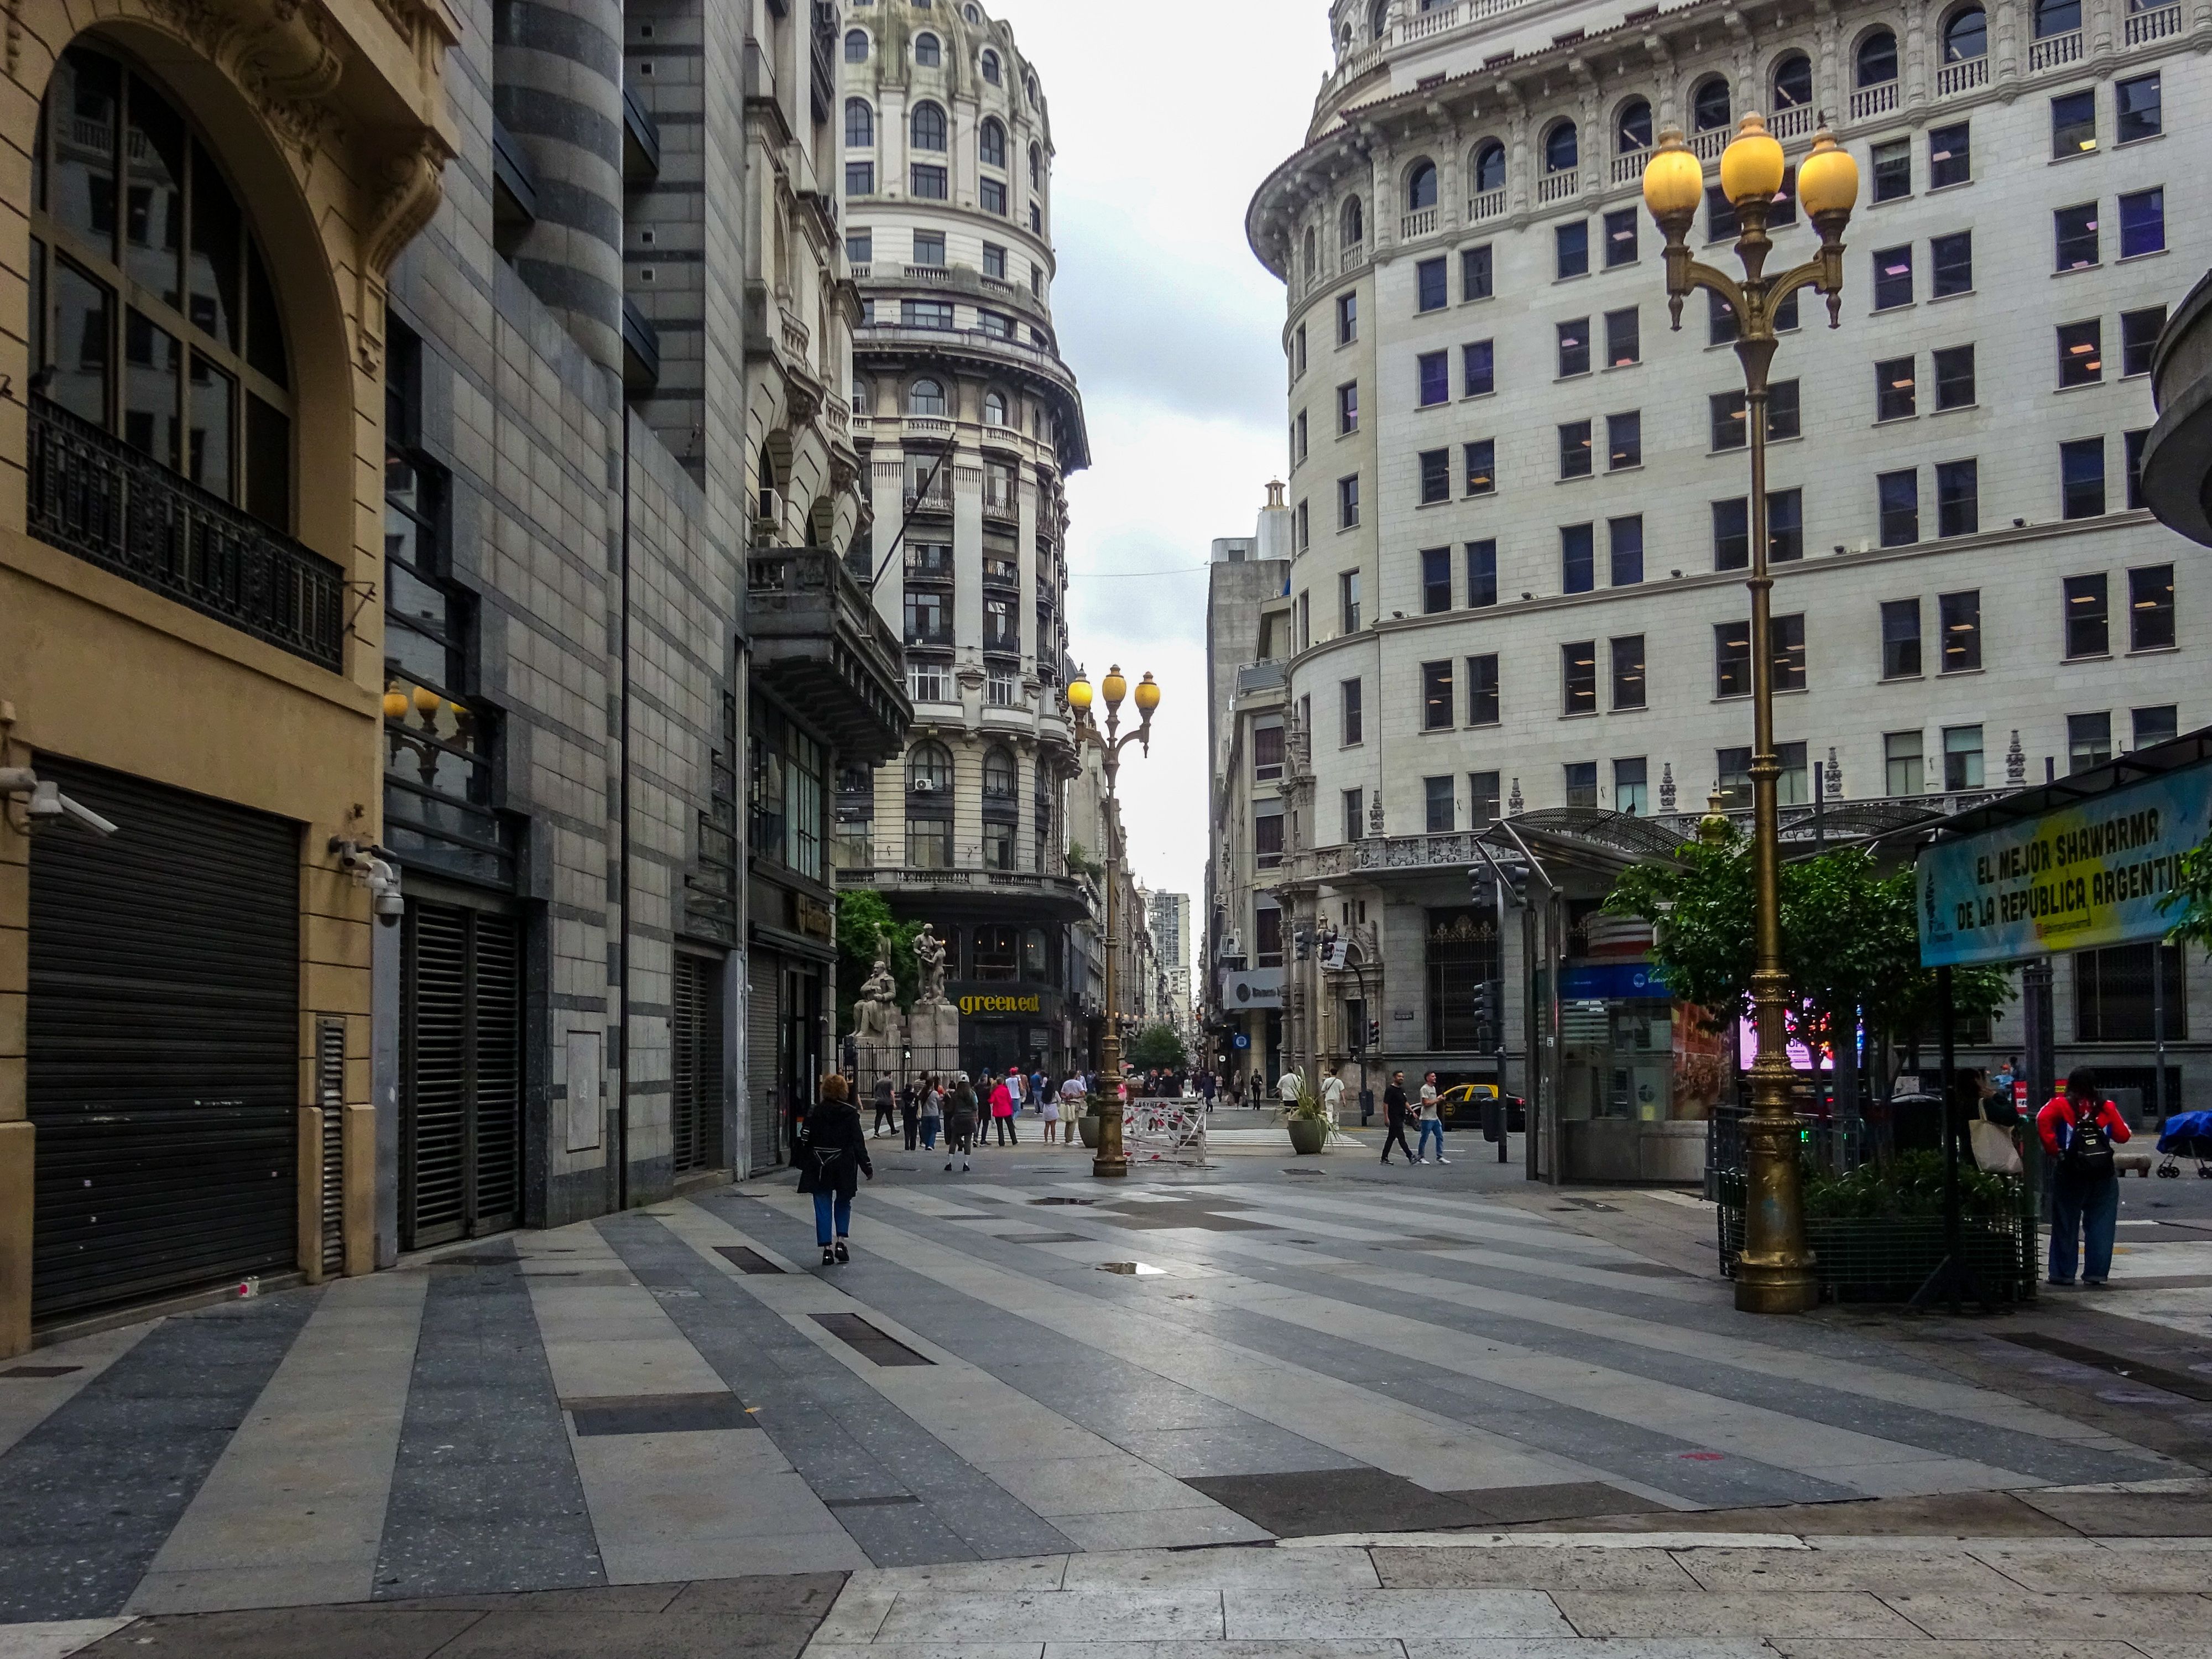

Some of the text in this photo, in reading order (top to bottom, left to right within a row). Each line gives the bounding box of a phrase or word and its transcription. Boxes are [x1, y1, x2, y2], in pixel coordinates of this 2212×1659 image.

[1978, 807, 2159, 885] EL MEJOR SHAWARMA
[1958, 852, 2188, 931] DE LA REPÚBLICA ARGENTIN
[959, 993, 1040, 1015] green eat
